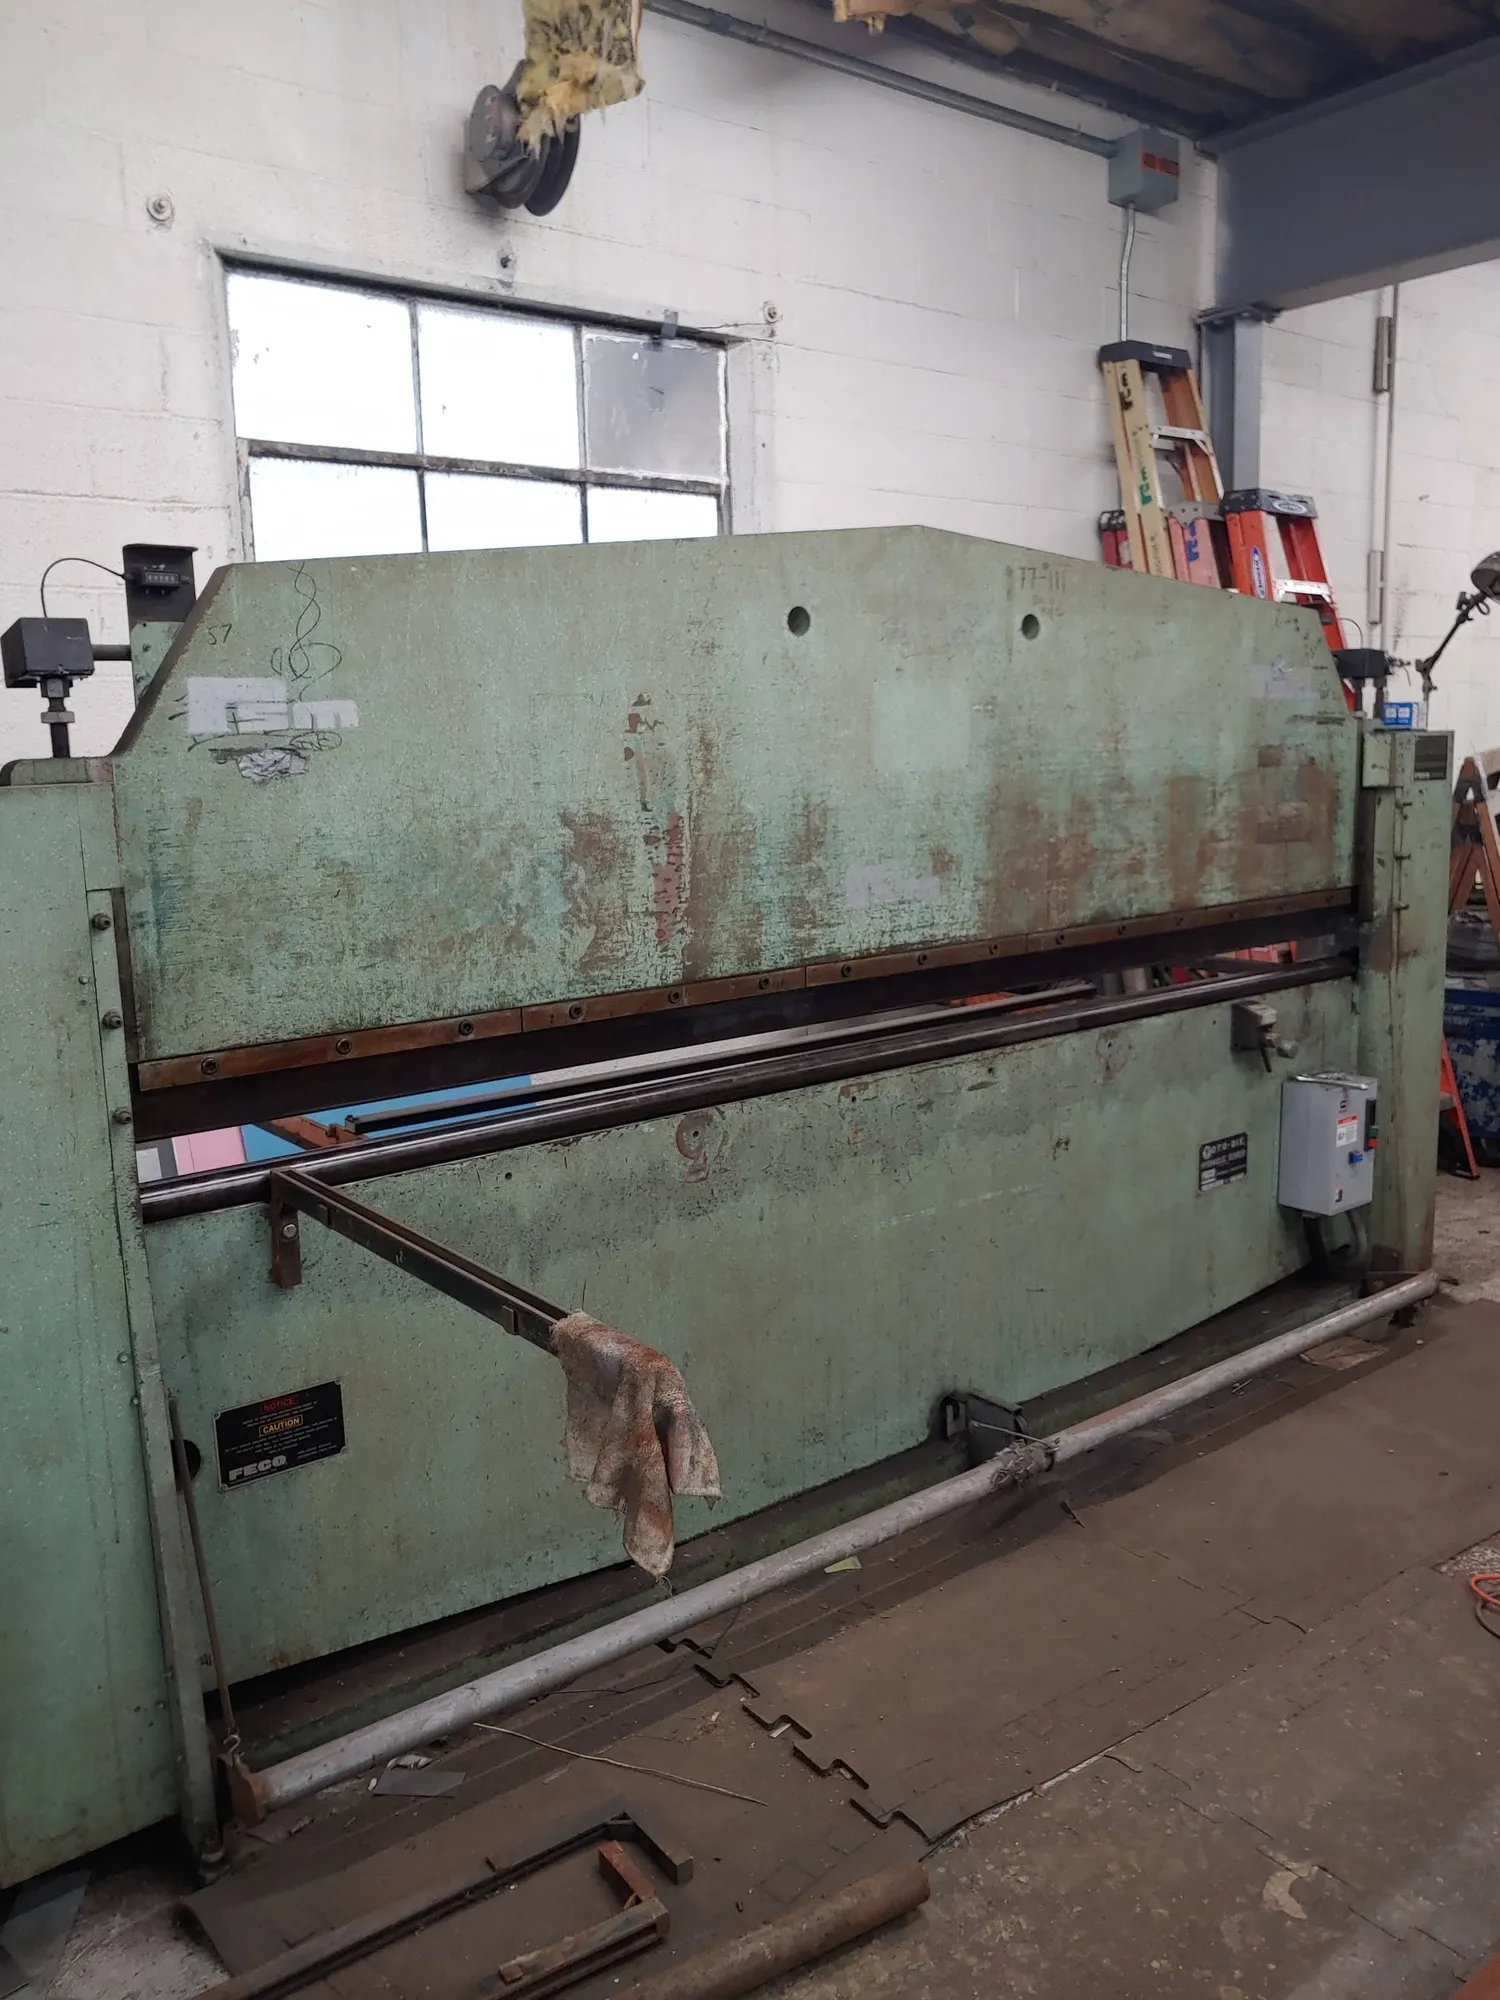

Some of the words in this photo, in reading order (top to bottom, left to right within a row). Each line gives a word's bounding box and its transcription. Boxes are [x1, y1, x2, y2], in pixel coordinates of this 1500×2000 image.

[263, 1398, 295, 1412] NOTICE
[262, 1417, 300, 1434] CAUTION
[228, 1454, 287, 1482] FECO
